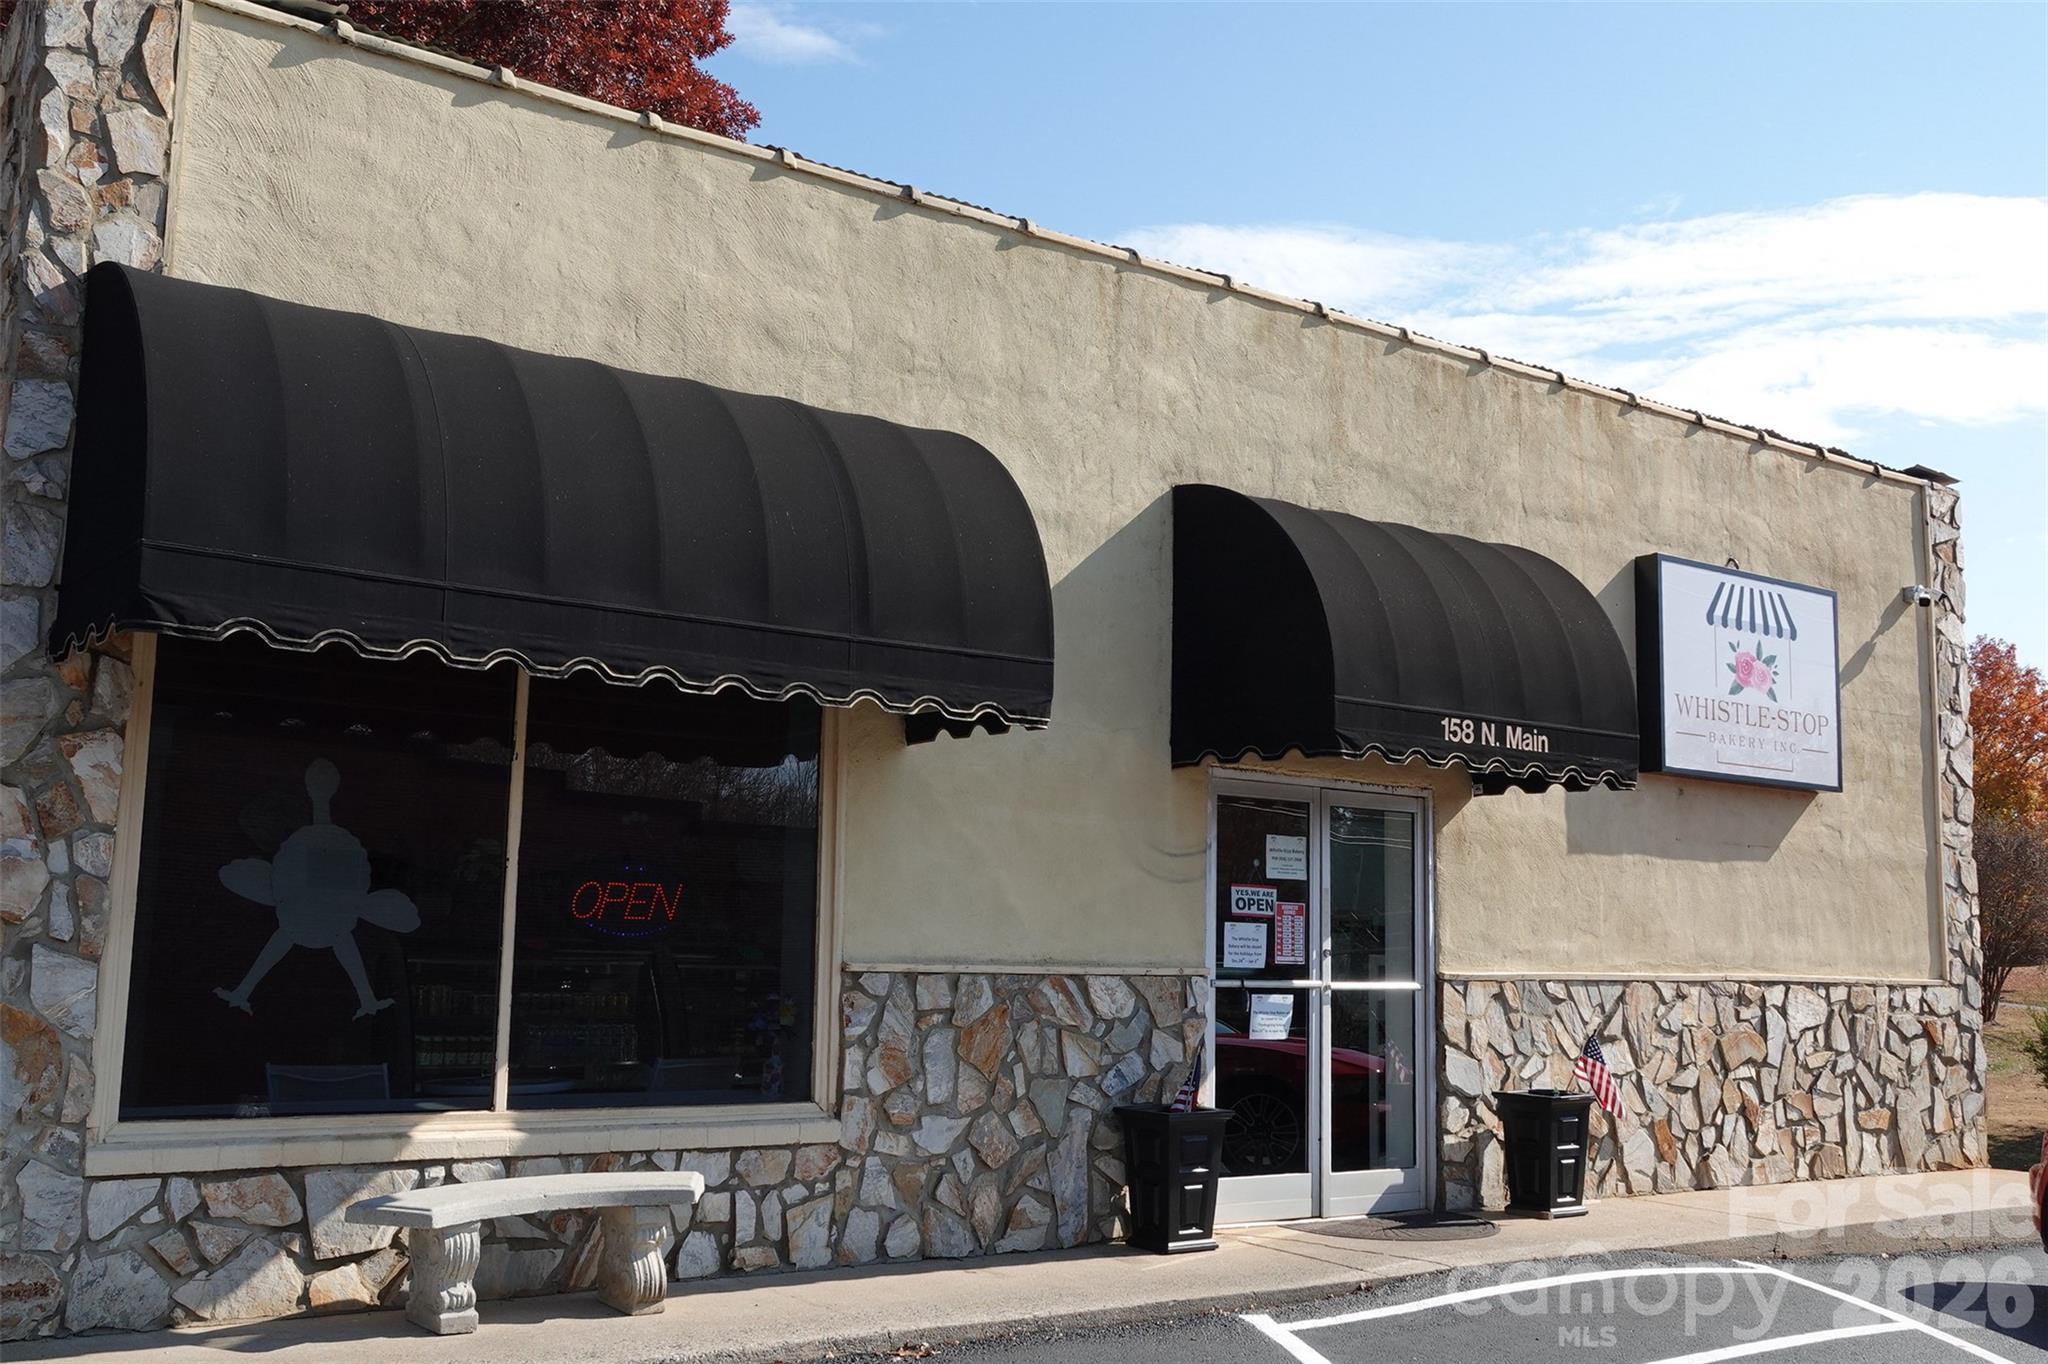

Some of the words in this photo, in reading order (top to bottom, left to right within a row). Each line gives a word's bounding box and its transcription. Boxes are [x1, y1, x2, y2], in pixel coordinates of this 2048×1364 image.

[1675, 693, 1829, 736] WHISTLE-STOP
[1441, 717, 1474, 744] 158
[1481, 721, 1500, 747] N.
[1506, 725, 1549, 753] Main
[1709, 731, 1766, 751] BAKERY
[571, 880, 685, 921] OPEN
[1235, 897, 1274, 912] OPEN
